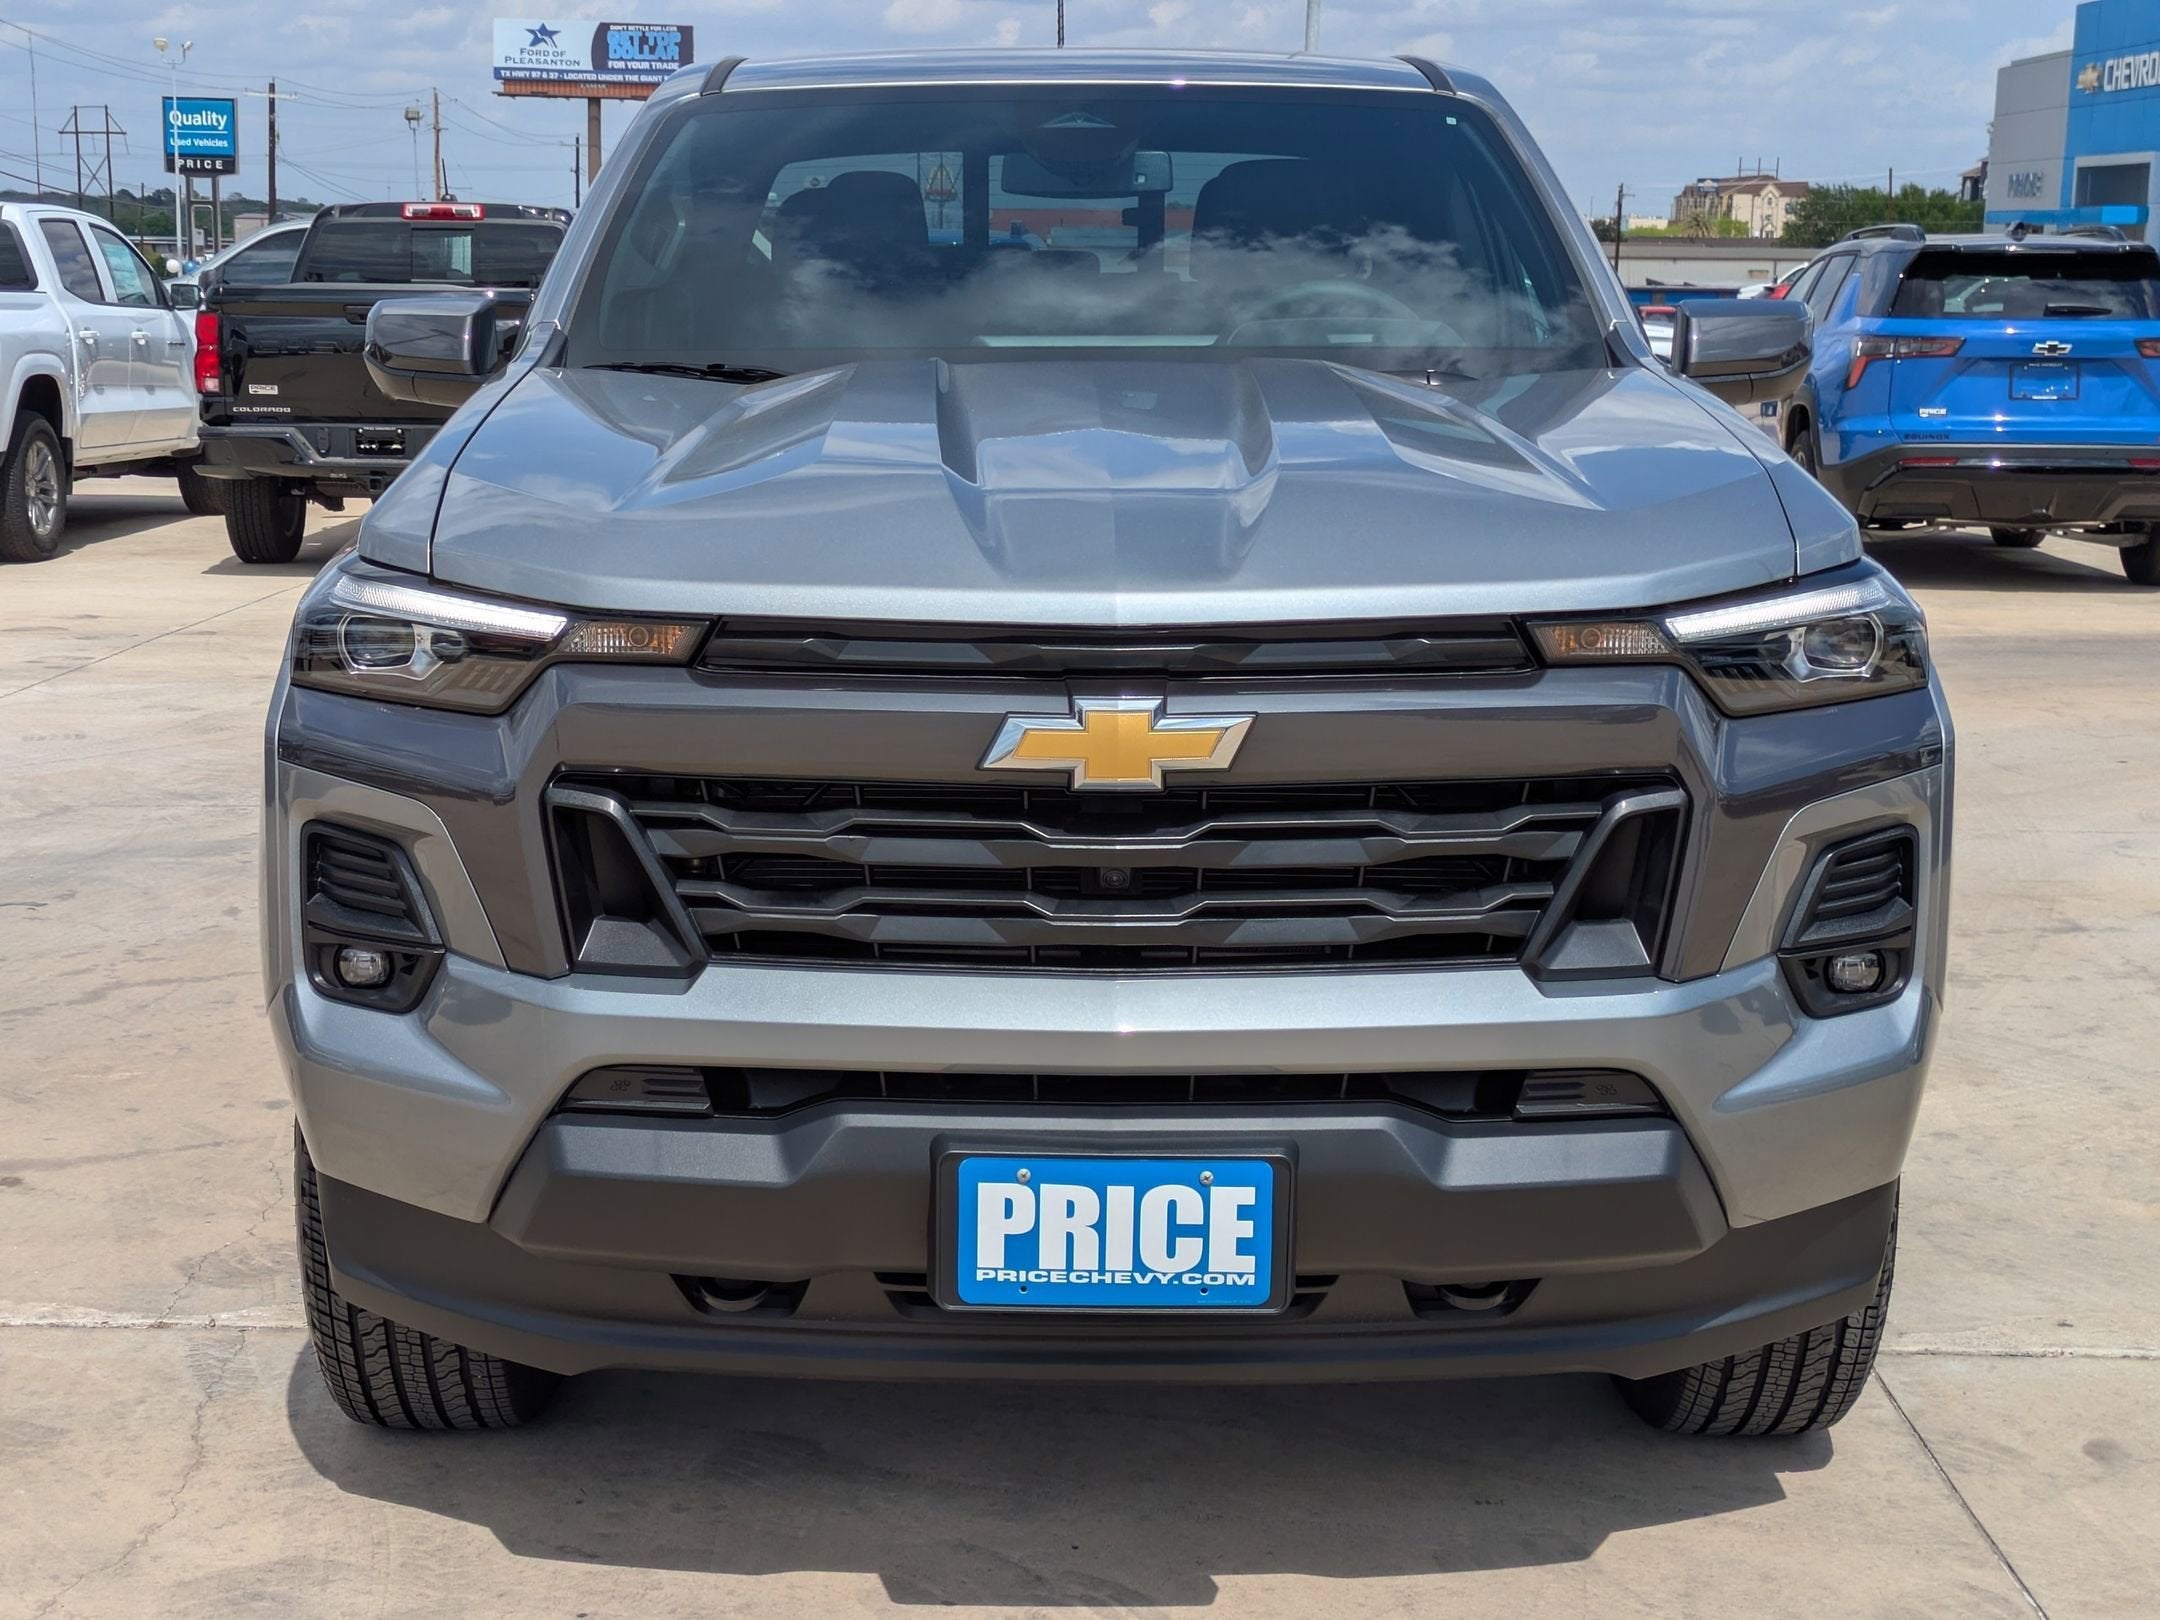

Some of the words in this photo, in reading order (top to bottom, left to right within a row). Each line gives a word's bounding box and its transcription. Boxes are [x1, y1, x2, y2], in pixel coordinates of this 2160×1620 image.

[519, 48, 550, 57] FORD
[552, 50, 567, 58] OF
[608, 43, 680, 60] DOLLAR
[504, 56, 581, 67] PLEASANTON
[608, 60, 626, 69] FOR
[627, 61, 650, 70] YOUR
[651, 62, 680, 70] TRADE
[512, 70, 530, 78] HWY
[564, 73, 597, 81] LOCATED
[598, 74, 624, 82] UNDER
[640, 75, 663, 83] GIANT
[2103, 52, 2160, 92] CHEVRO
[169, 110, 227, 129] Quality
[193, 138, 228, 147] Vehicles
[177, 159, 224, 169] PRICE
[977, 1182, 1256, 1273] PRICE
[976, 1269, 1256, 1286] PRICECHEVY.COM
